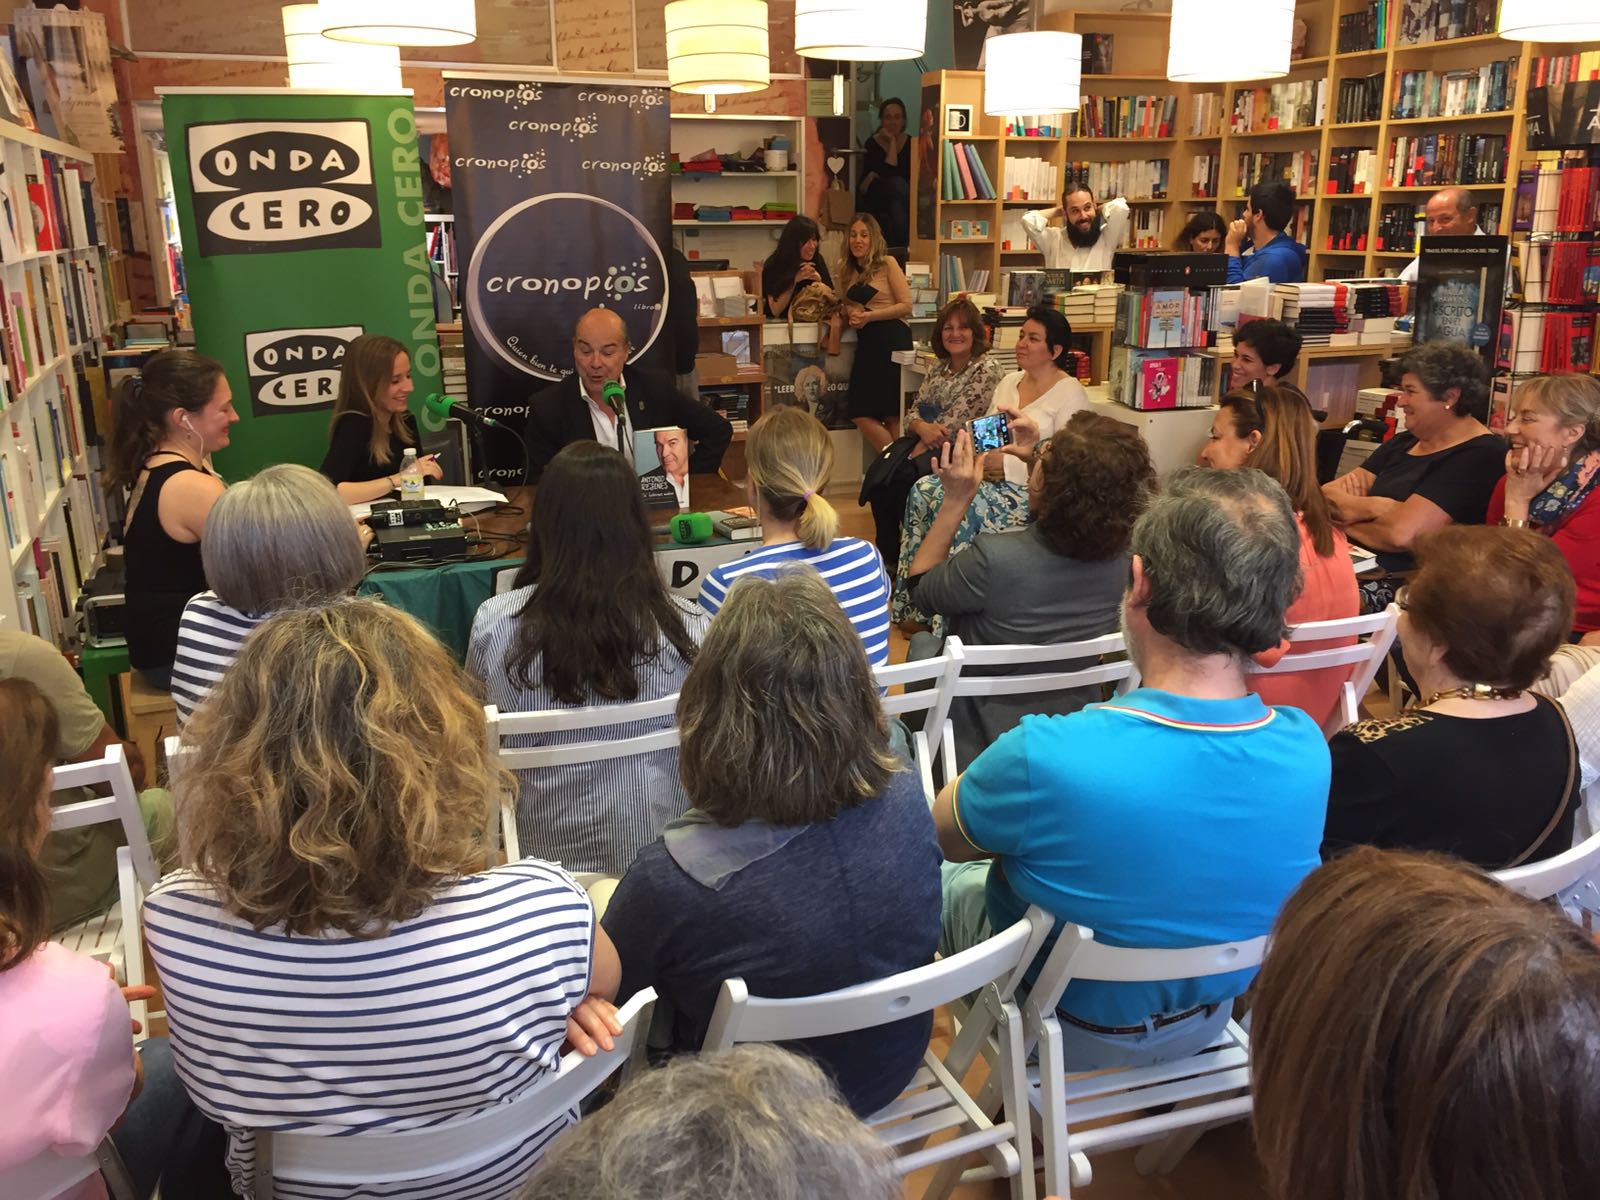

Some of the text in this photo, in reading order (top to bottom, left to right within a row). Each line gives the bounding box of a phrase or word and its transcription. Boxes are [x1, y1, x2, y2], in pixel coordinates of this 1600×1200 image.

[450, 86, 543, 103] cronopios
[578, 91, 664, 108] cronopios
[508, 120, 599, 136] cronopios
[214, 148, 346, 176] ONDA
[455, 156, 547, 173] cronopios
[582, 158, 666, 175] cronopios
[229, 198, 351, 231] CERO
[387, 107, 441, 377] ONDA CERO
[486, 274, 650, 300] cronopios
[263, 345, 345, 366] ONDA
[507, 336, 528, 361] Quien
[530, 354, 546, 371] bien
[560, 368, 574, 378] qui
[272, 377, 332, 399] CER
